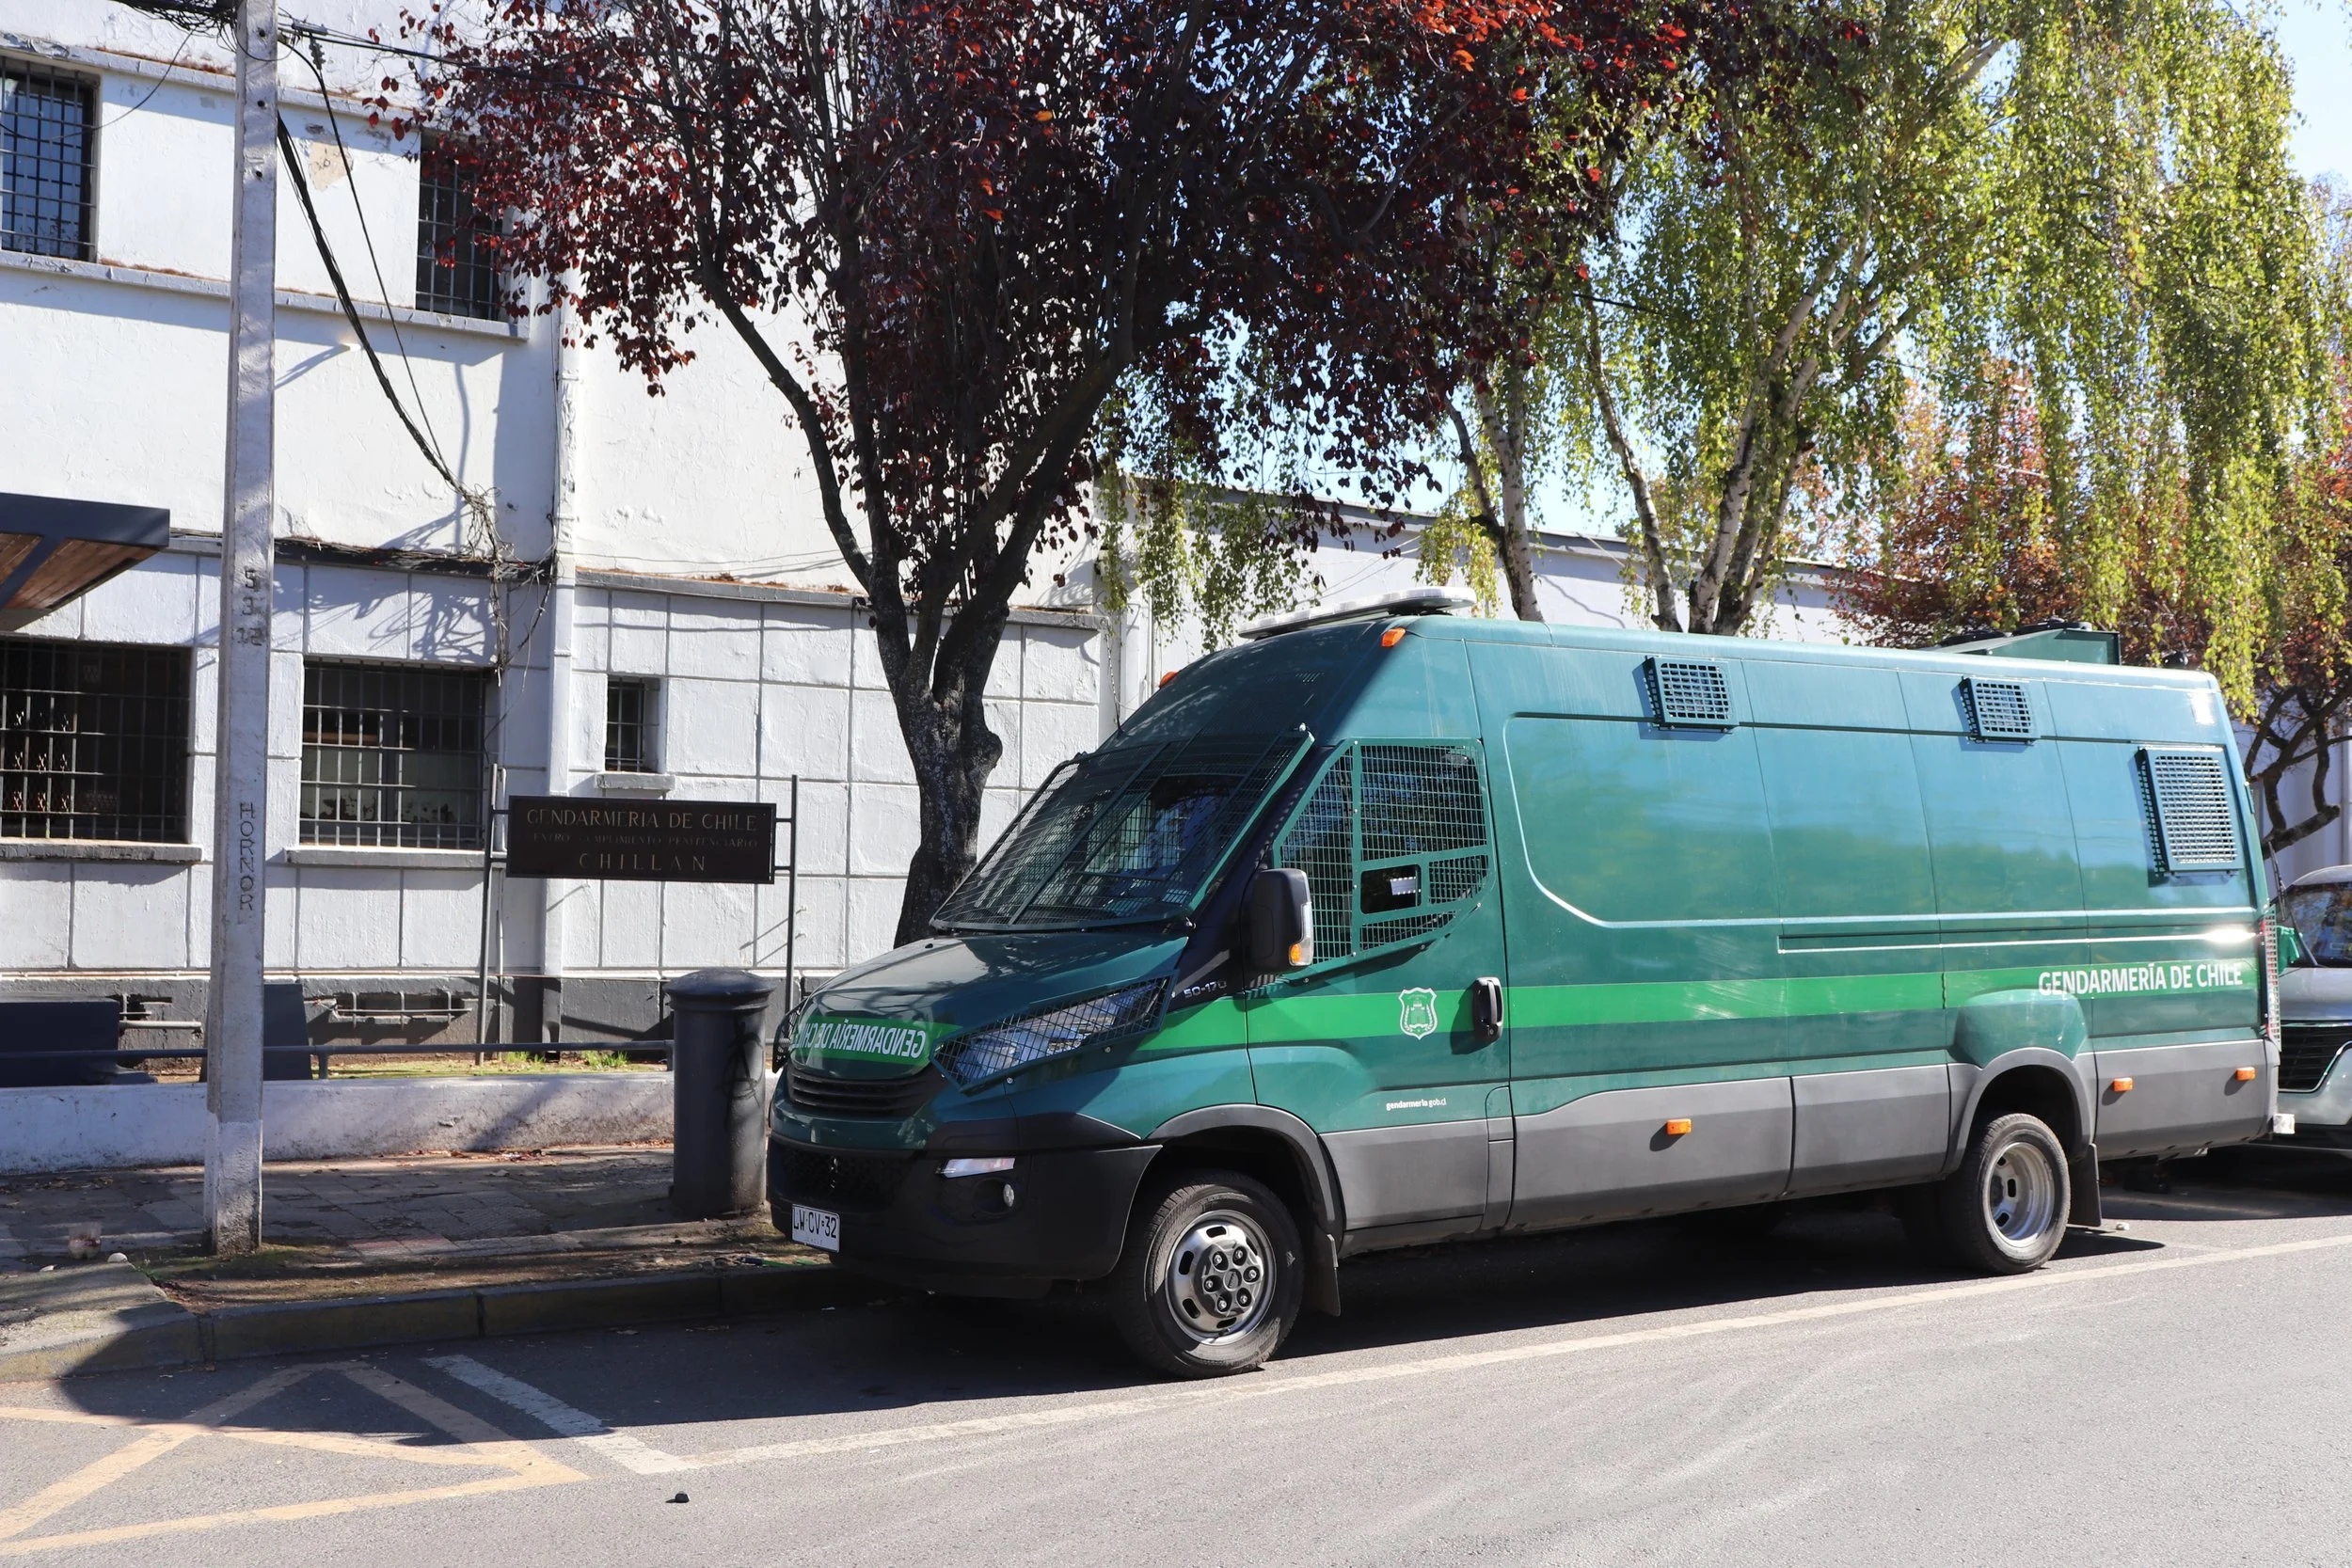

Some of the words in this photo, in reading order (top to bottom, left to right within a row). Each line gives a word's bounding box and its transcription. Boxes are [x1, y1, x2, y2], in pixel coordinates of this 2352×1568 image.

[669, 813, 692, 829] DE
[702, 814, 756, 832] CHILE
[239, 802, 256, 911] HORNOR
[580, 852, 706, 872] CHILLAN
[2169, 964, 2193, 990] DE
[2196, 962, 2243, 988] CHILE
